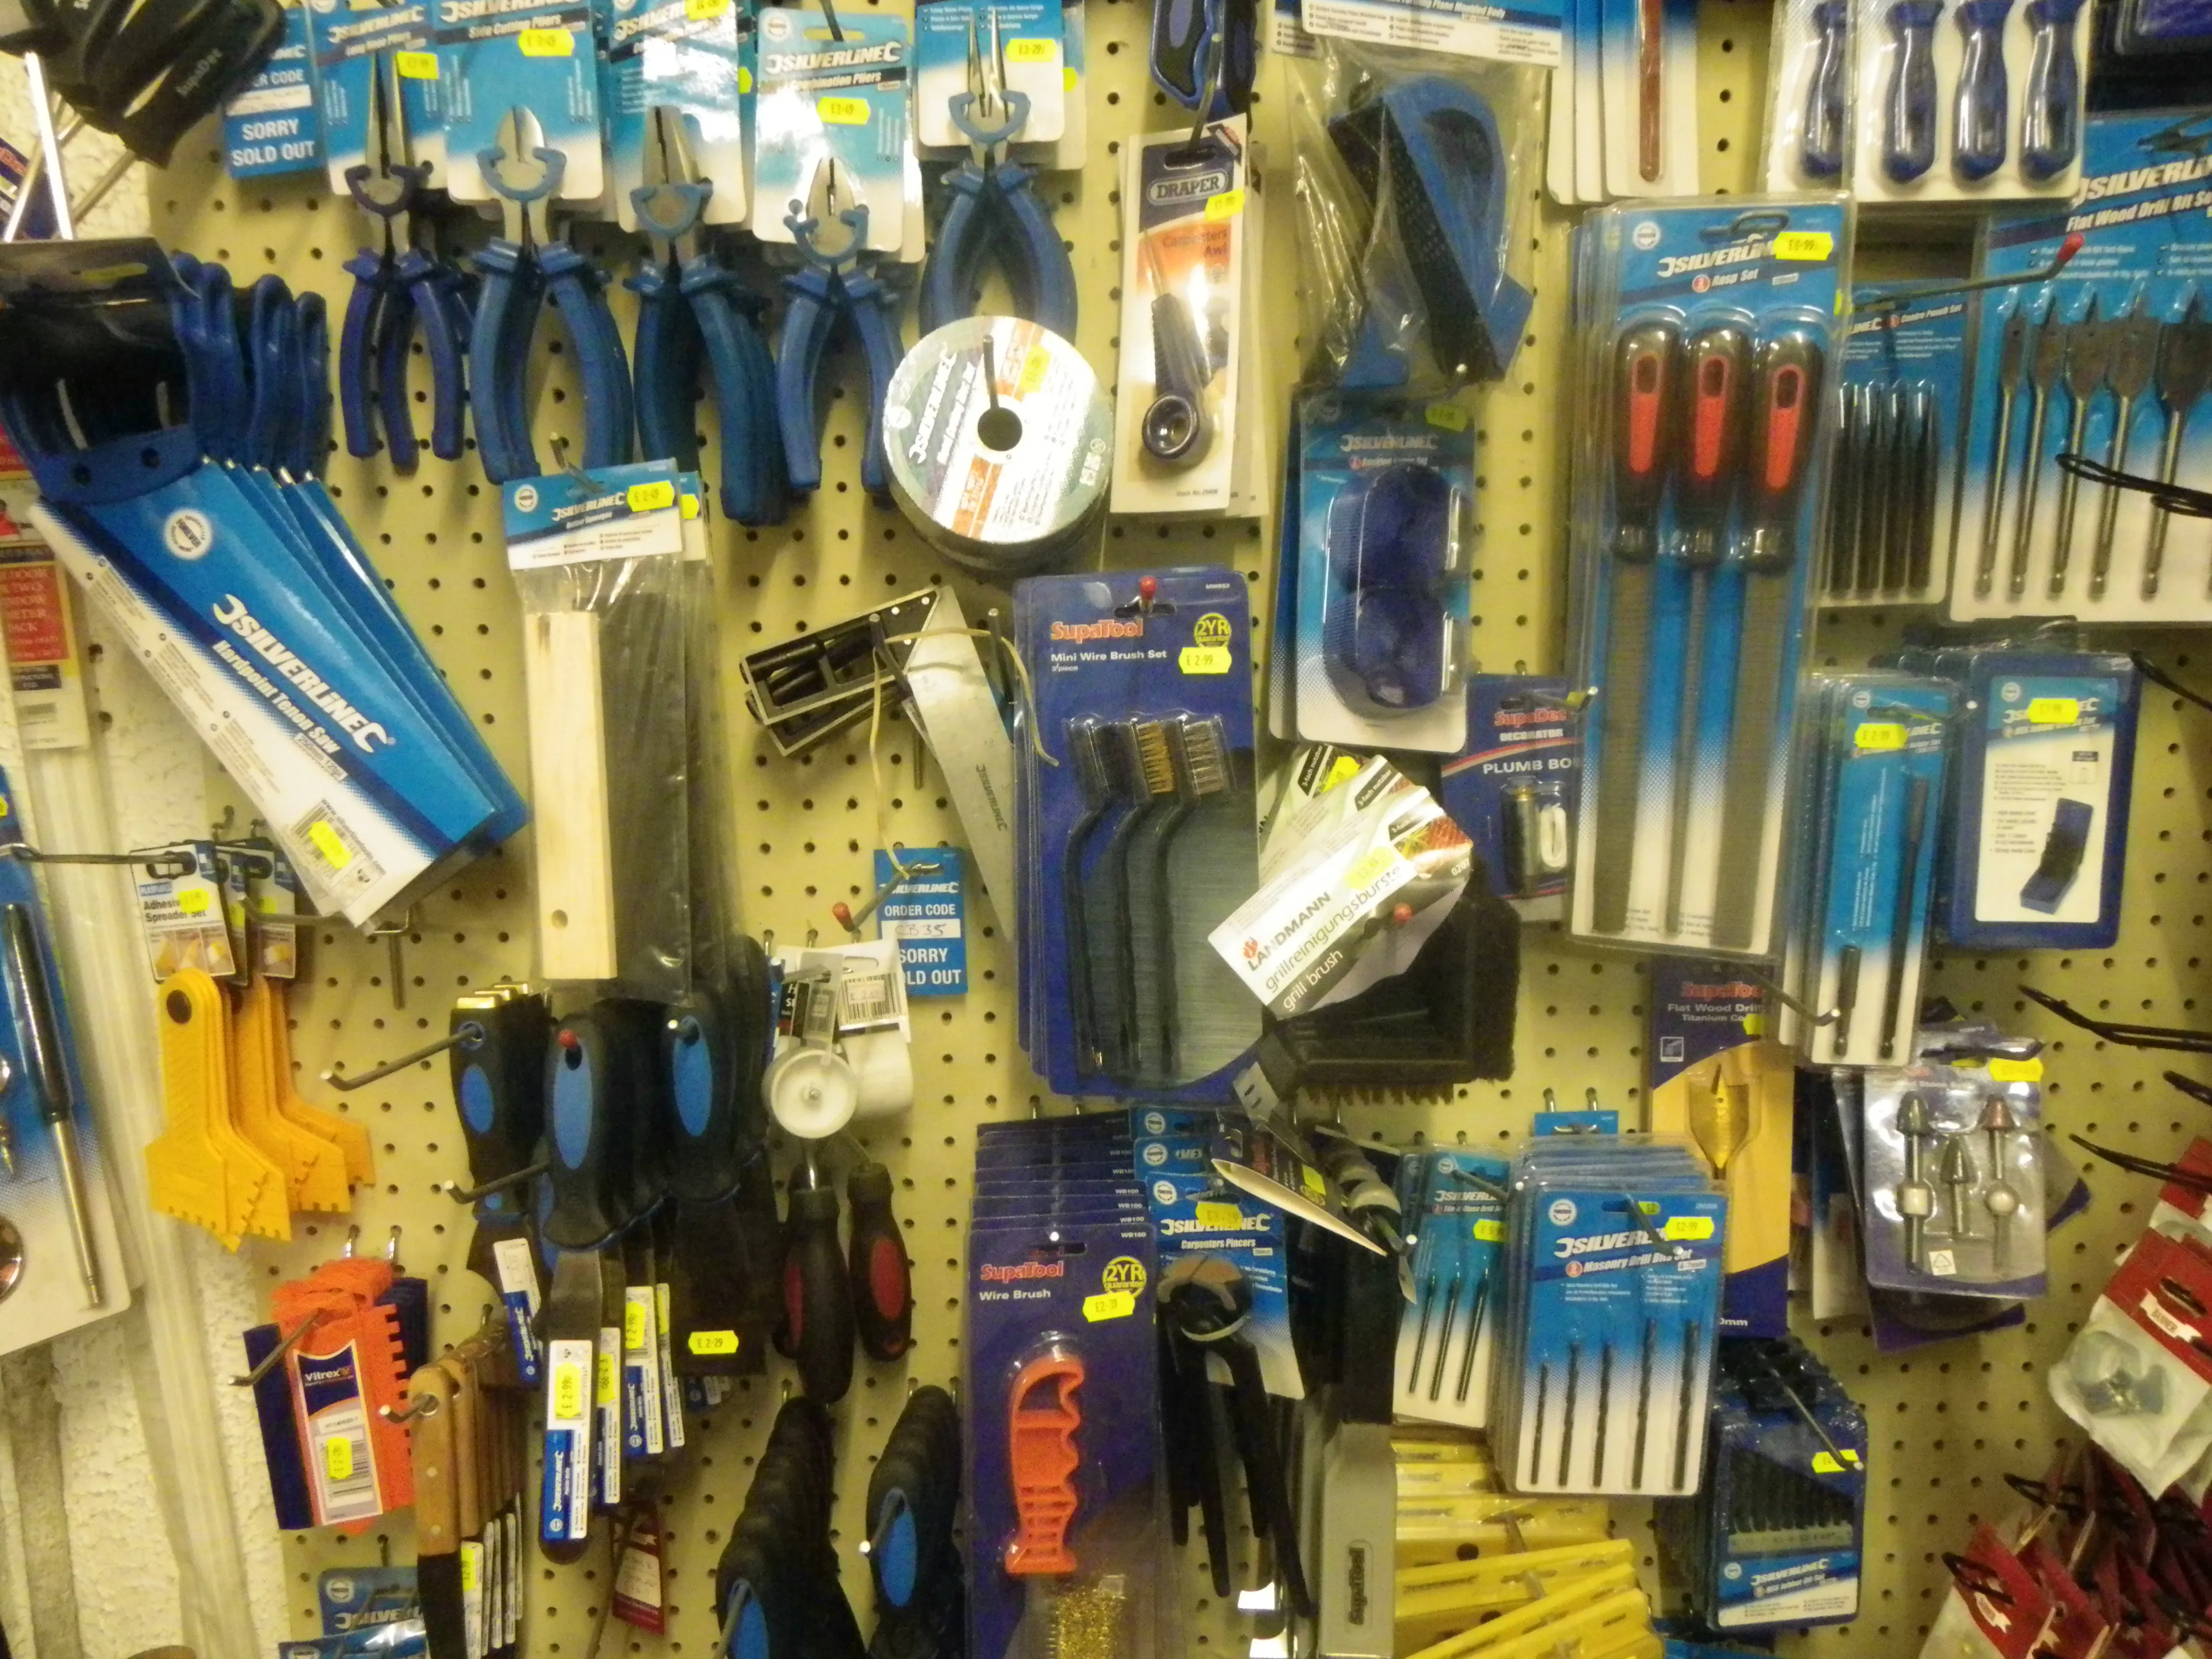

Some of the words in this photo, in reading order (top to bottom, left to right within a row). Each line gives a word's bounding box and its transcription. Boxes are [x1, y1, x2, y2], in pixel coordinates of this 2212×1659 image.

[776, 43, 891, 74] SILVERLINE
[270, 69, 304, 84] CODE
[853, 72, 882, 85] Pliers
[242, 118, 299, 140] SORRY
[231, 145, 277, 166] SOLD
[280, 140, 315, 160] OUT
[1156, 175, 1220, 199] DRAPER
[2065, 213, 2094, 233] Flat
[2094, 204, 2138, 226] Wood
[1206, 244, 1227, 255] Awl
[1740, 268, 1759, 282] Set
[1050, 618, 1144, 644] SupaTool
[1197, 619, 1229, 636] 2YR
[1051, 653, 1077, 662] Mini
[1079, 651, 1108, 662] Wire
[1110, 650, 1145, 660] Brush
[1147, 649, 1167, 659] Set
[223, 606, 379, 742] SILVERLINE
[212, 640, 279, 698] Hardpoint
[272, 692, 315, 731] Tenon
[308, 726, 341, 754] Saw
[1500, 728, 1564, 742] DECORATOR
[1482, 759, 1542, 775] PLUMB
[891, 881, 951, 895] ILVERLINE
[143, 898, 180, 911] Adhesiv
[884, 905, 922, 916] ORDER
[925, 904, 956, 915] CODE
[145, 911, 188, 924] Spreader
[1247, 891, 1332, 972] LANDMANN
[900, 947, 949, 963] SORRY
[930, 969, 962, 985] OUT
[1283, 982, 1308, 1013] grill
[1305, 949, 1344, 987] brush
[1667, 1004, 1692, 1013] Flat
[1694, 1003, 1733, 1012] Wood
[1181, 1239, 1225, 1250] Carpenters
[1225, 1238, 1256, 1248] Pincers
[1583, 1258, 1630, 1274] Masonry
[1629, 1253, 1652, 1266] Drill
[980, 1260, 1064, 1284] SupaTool
[1105, 1265, 1144, 1282] 2YR
[979, 1291, 1010, 1301] Wire
[1013, 1288, 1051, 1300] Brush
[304, 1370, 340, 1383] Vitrex
